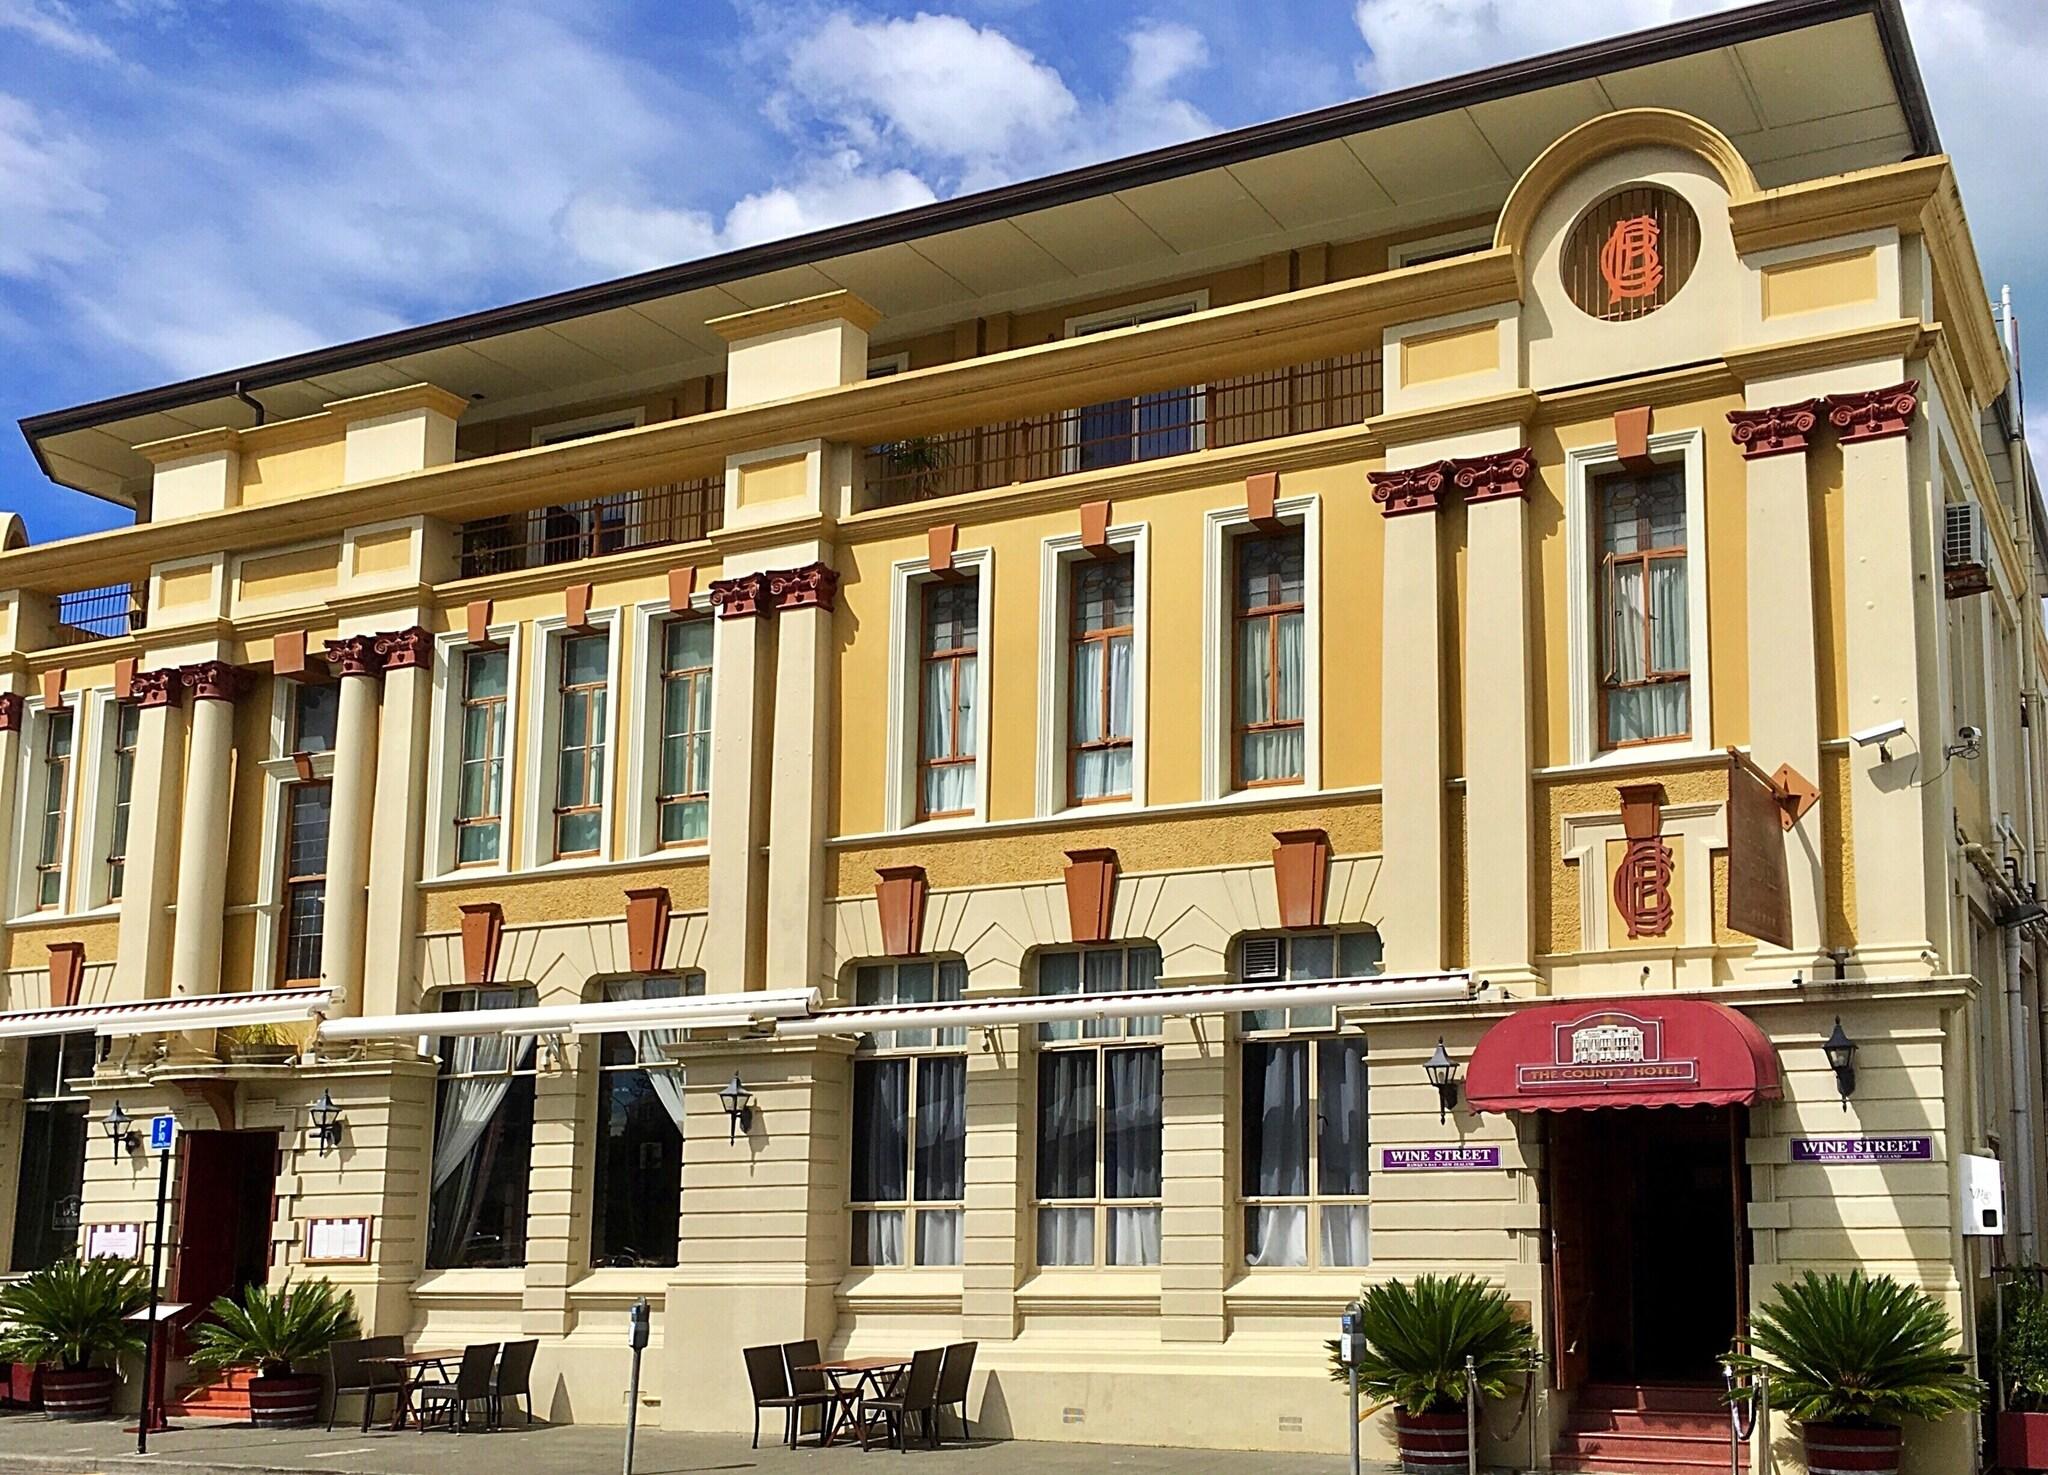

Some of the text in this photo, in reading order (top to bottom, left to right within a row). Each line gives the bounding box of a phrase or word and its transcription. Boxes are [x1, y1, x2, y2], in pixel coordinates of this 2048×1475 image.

[1530, 1066, 1682, 1080] THE COUNTY HOTEL
[159, 1120, 167, 1132] P
[1802, 1140, 1921, 1153] WINE STREET
[1391, 1149, 1491, 1161] WINE STREET
